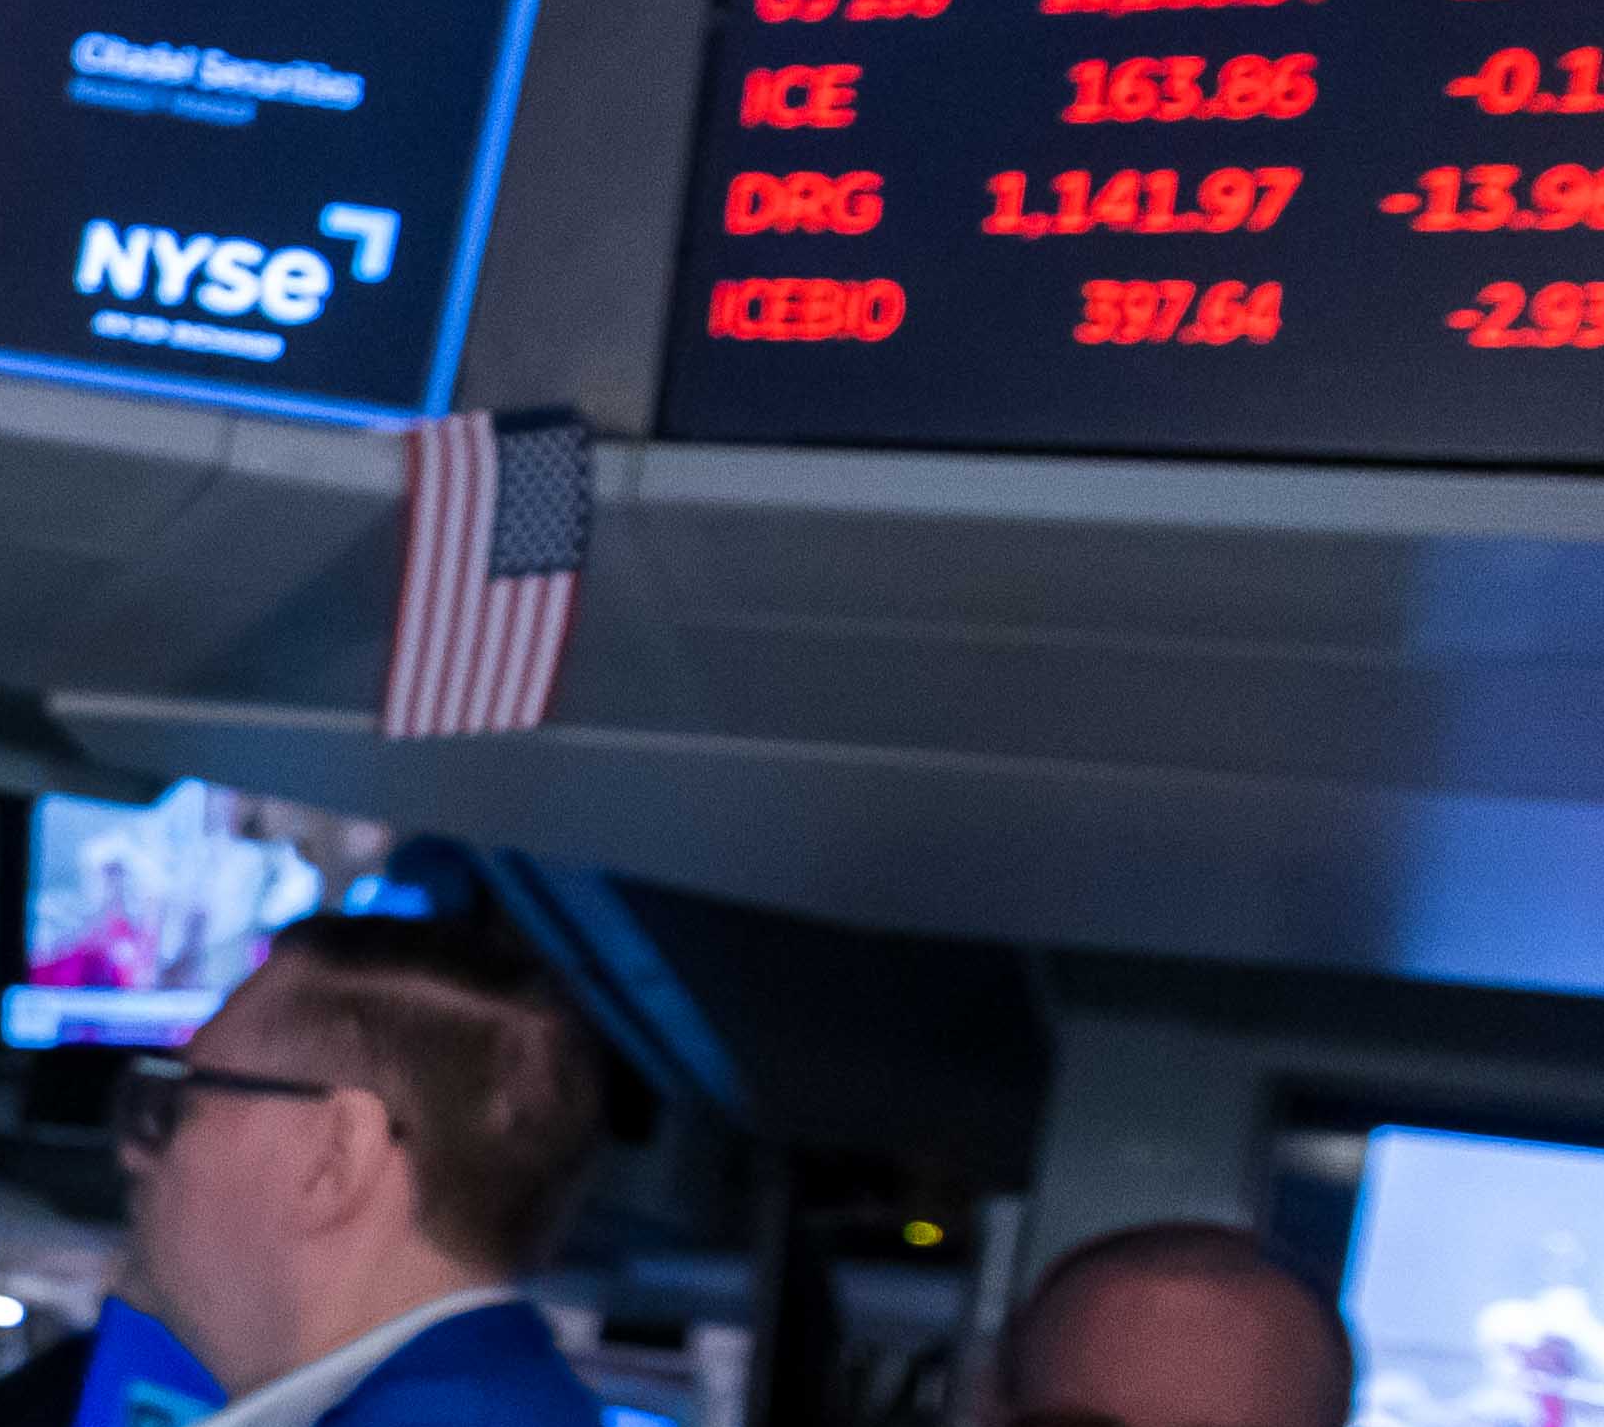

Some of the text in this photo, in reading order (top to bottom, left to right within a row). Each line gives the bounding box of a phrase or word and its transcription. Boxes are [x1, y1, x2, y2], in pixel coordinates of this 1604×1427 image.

[739, 62, 864, 130] ICE
[1061, 52, 1320, 125] 163.86
[724, 170, 886, 236] DRG
[982, 165, 1305, 239] 1,141.97
[1071, 278, 1284, 345] 397.64
